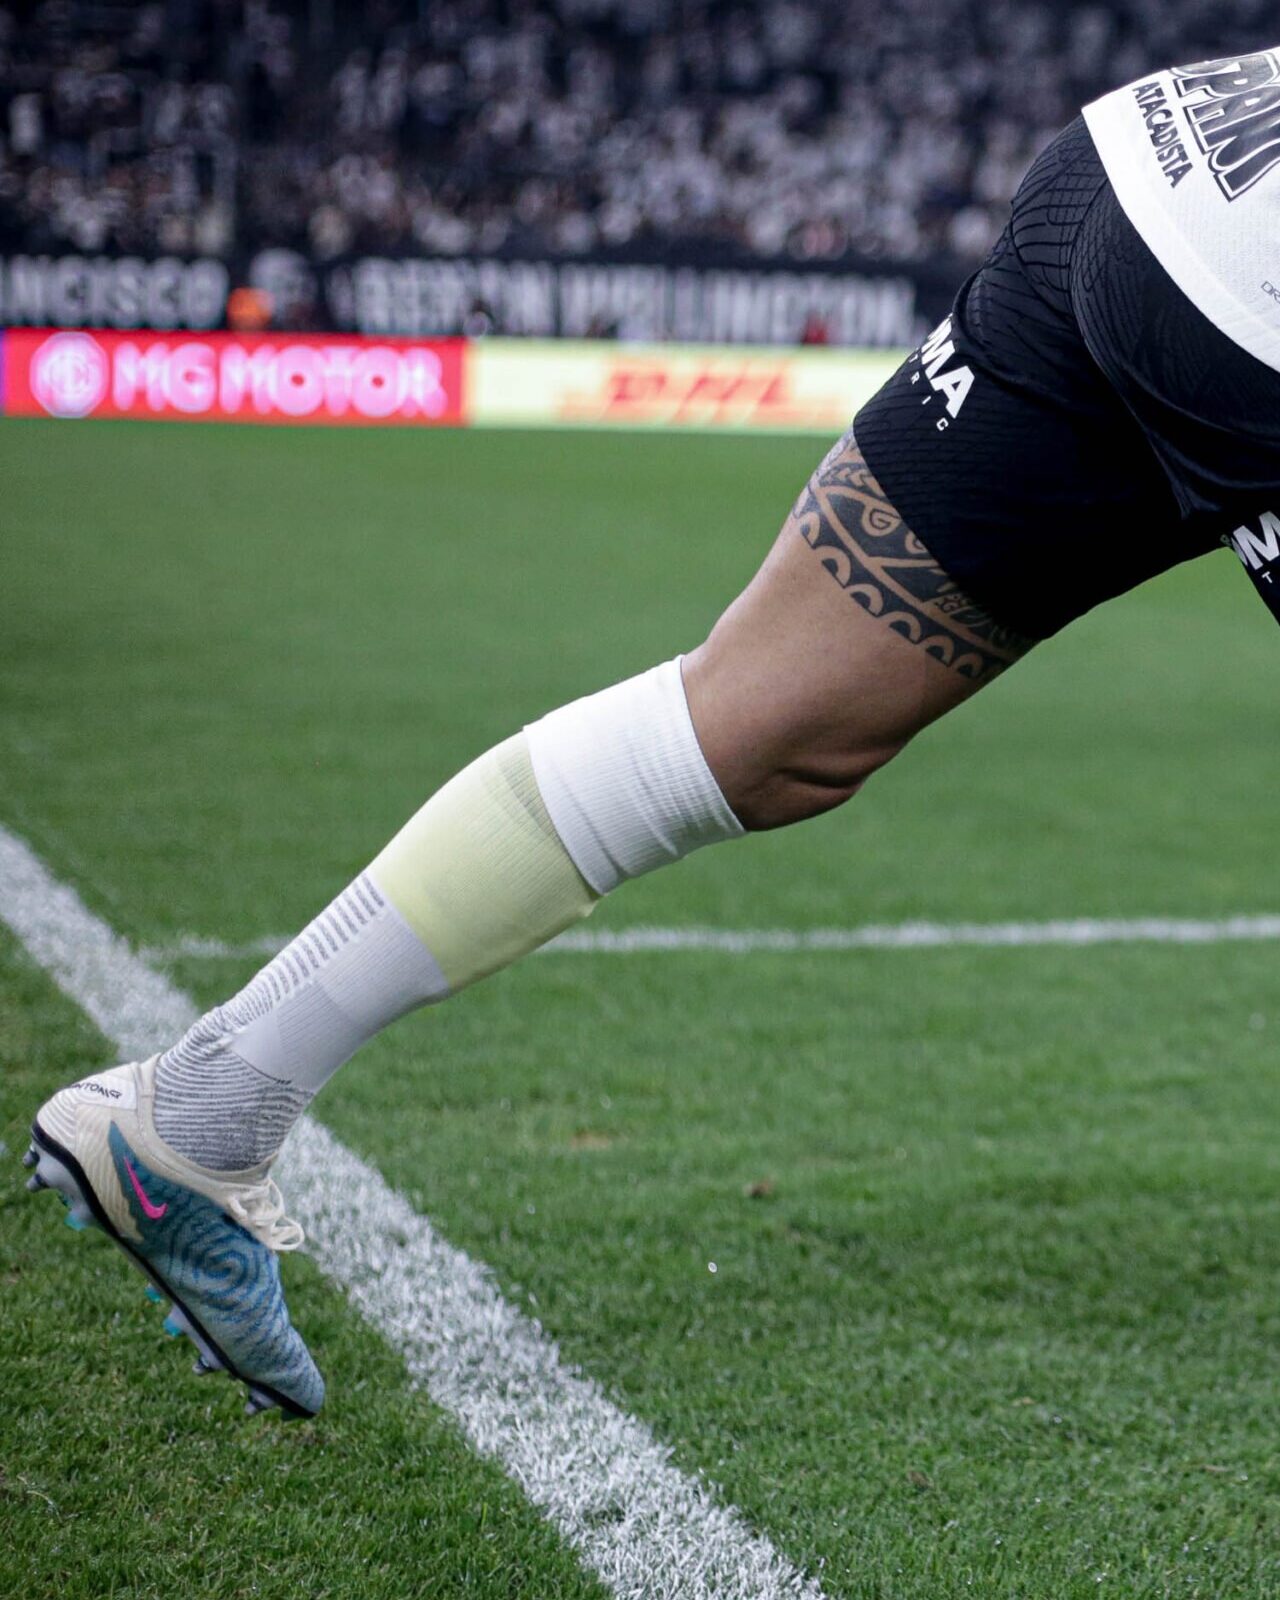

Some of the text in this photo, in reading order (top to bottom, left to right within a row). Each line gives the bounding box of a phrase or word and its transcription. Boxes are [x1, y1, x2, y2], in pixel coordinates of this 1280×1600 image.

[1132, 81, 1194, 189] ATACADISTA
[113, 342, 217, 413] MG
[219, 344, 448, 418] MOTOR
